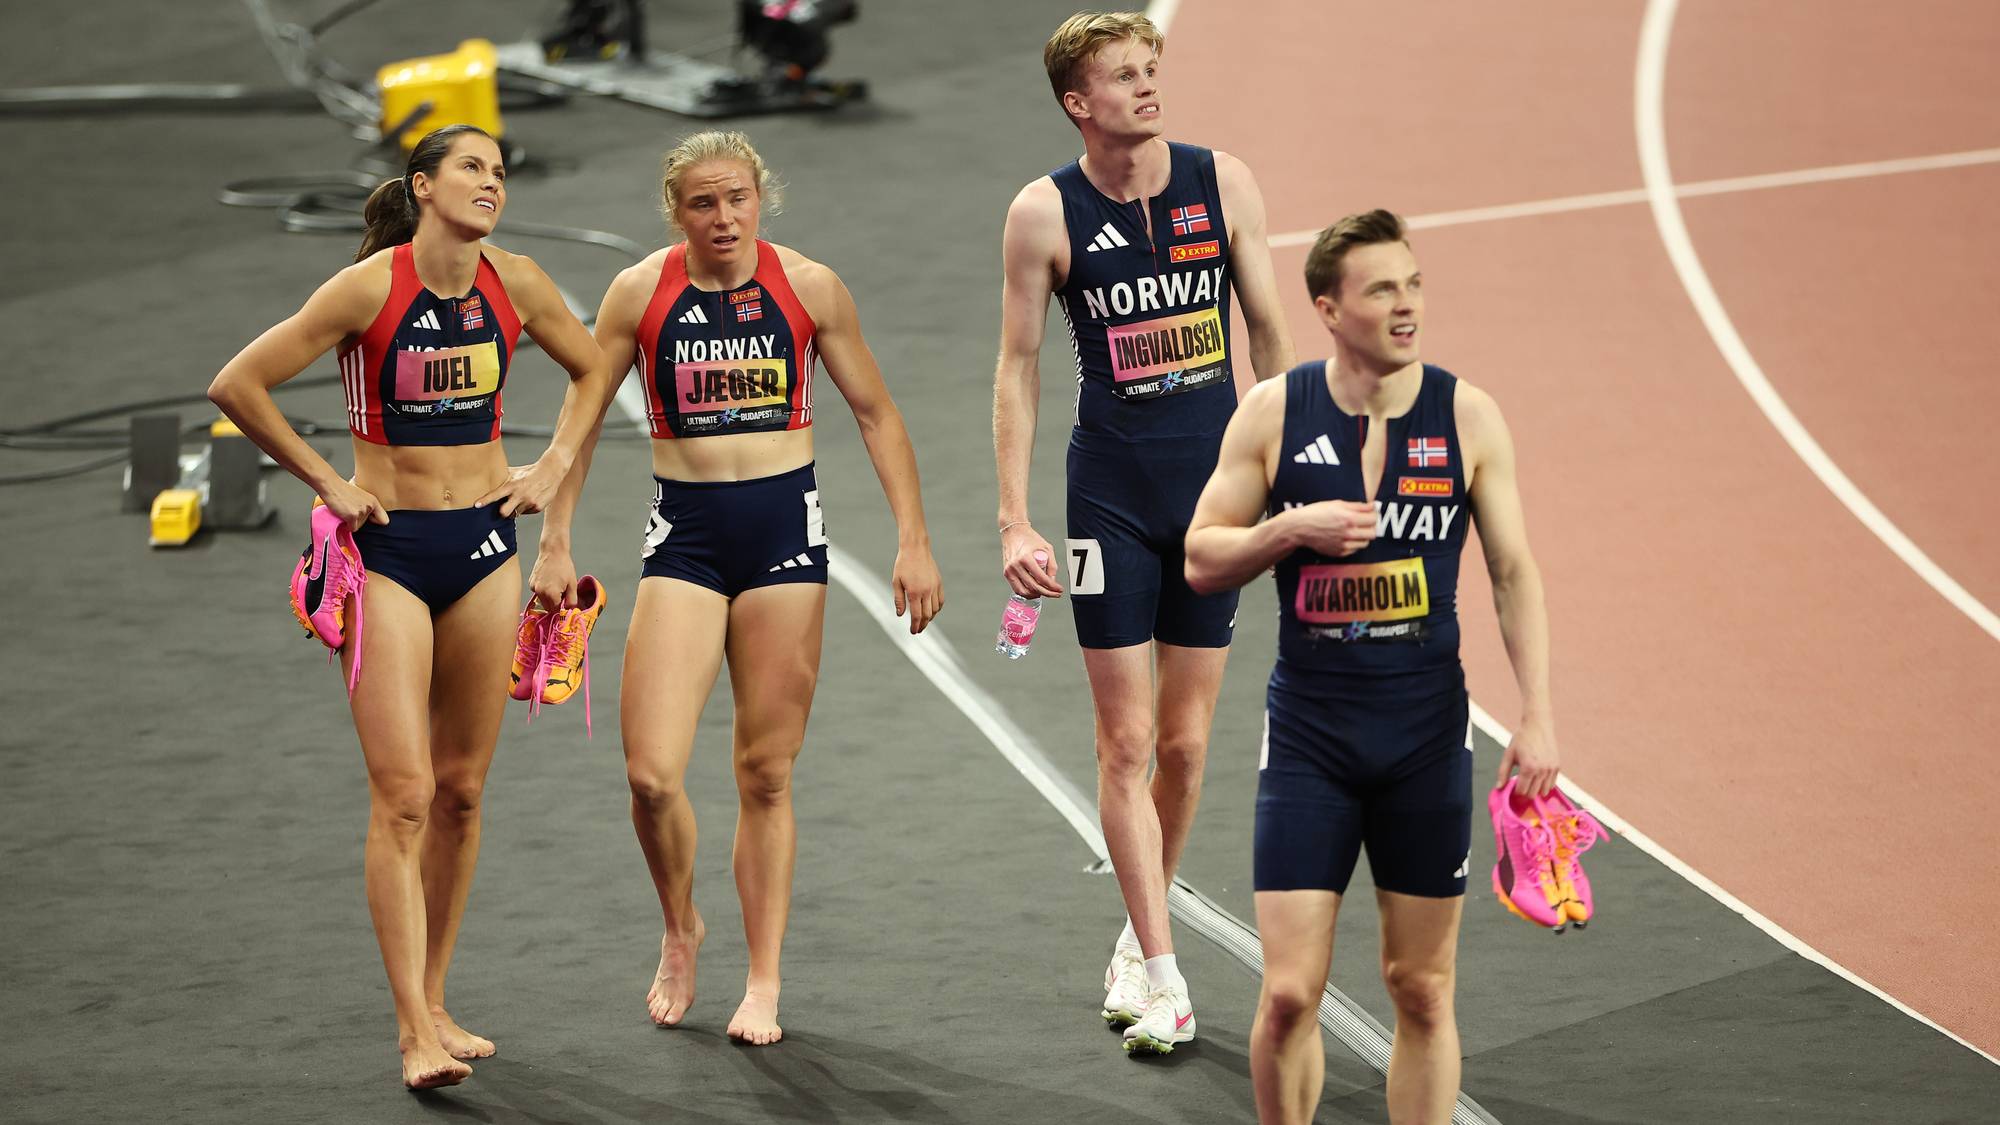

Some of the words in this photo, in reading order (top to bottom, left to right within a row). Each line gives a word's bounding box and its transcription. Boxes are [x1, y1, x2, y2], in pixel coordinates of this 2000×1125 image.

[1188, 245, 1217, 257] EXTRA
[1083, 264, 1226, 319] NORWAY
[675, 334, 777, 364] NORWAY
[1114, 318, 1222, 371] INGVALDSEN
[423, 356, 477, 393] IUEL
[686, 368, 780, 405] JÆGER
[1125, 382, 1160, 396] ULTIMATE
[1183, 369, 1215, 386] BUDAPEST
[401, 404, 433, 414] ULTIMATE
[453, 398, 485, 411] BUDAPEST
[687, 415, 718, 426] ULTIMATE
[740, 409, 773, 422] BUDAPEST
[1418, 481, 1450, 494] EXTRA
[1072, 548, 1089, 587] 7
[1305, 572, 1422, 613] WARHOLM
